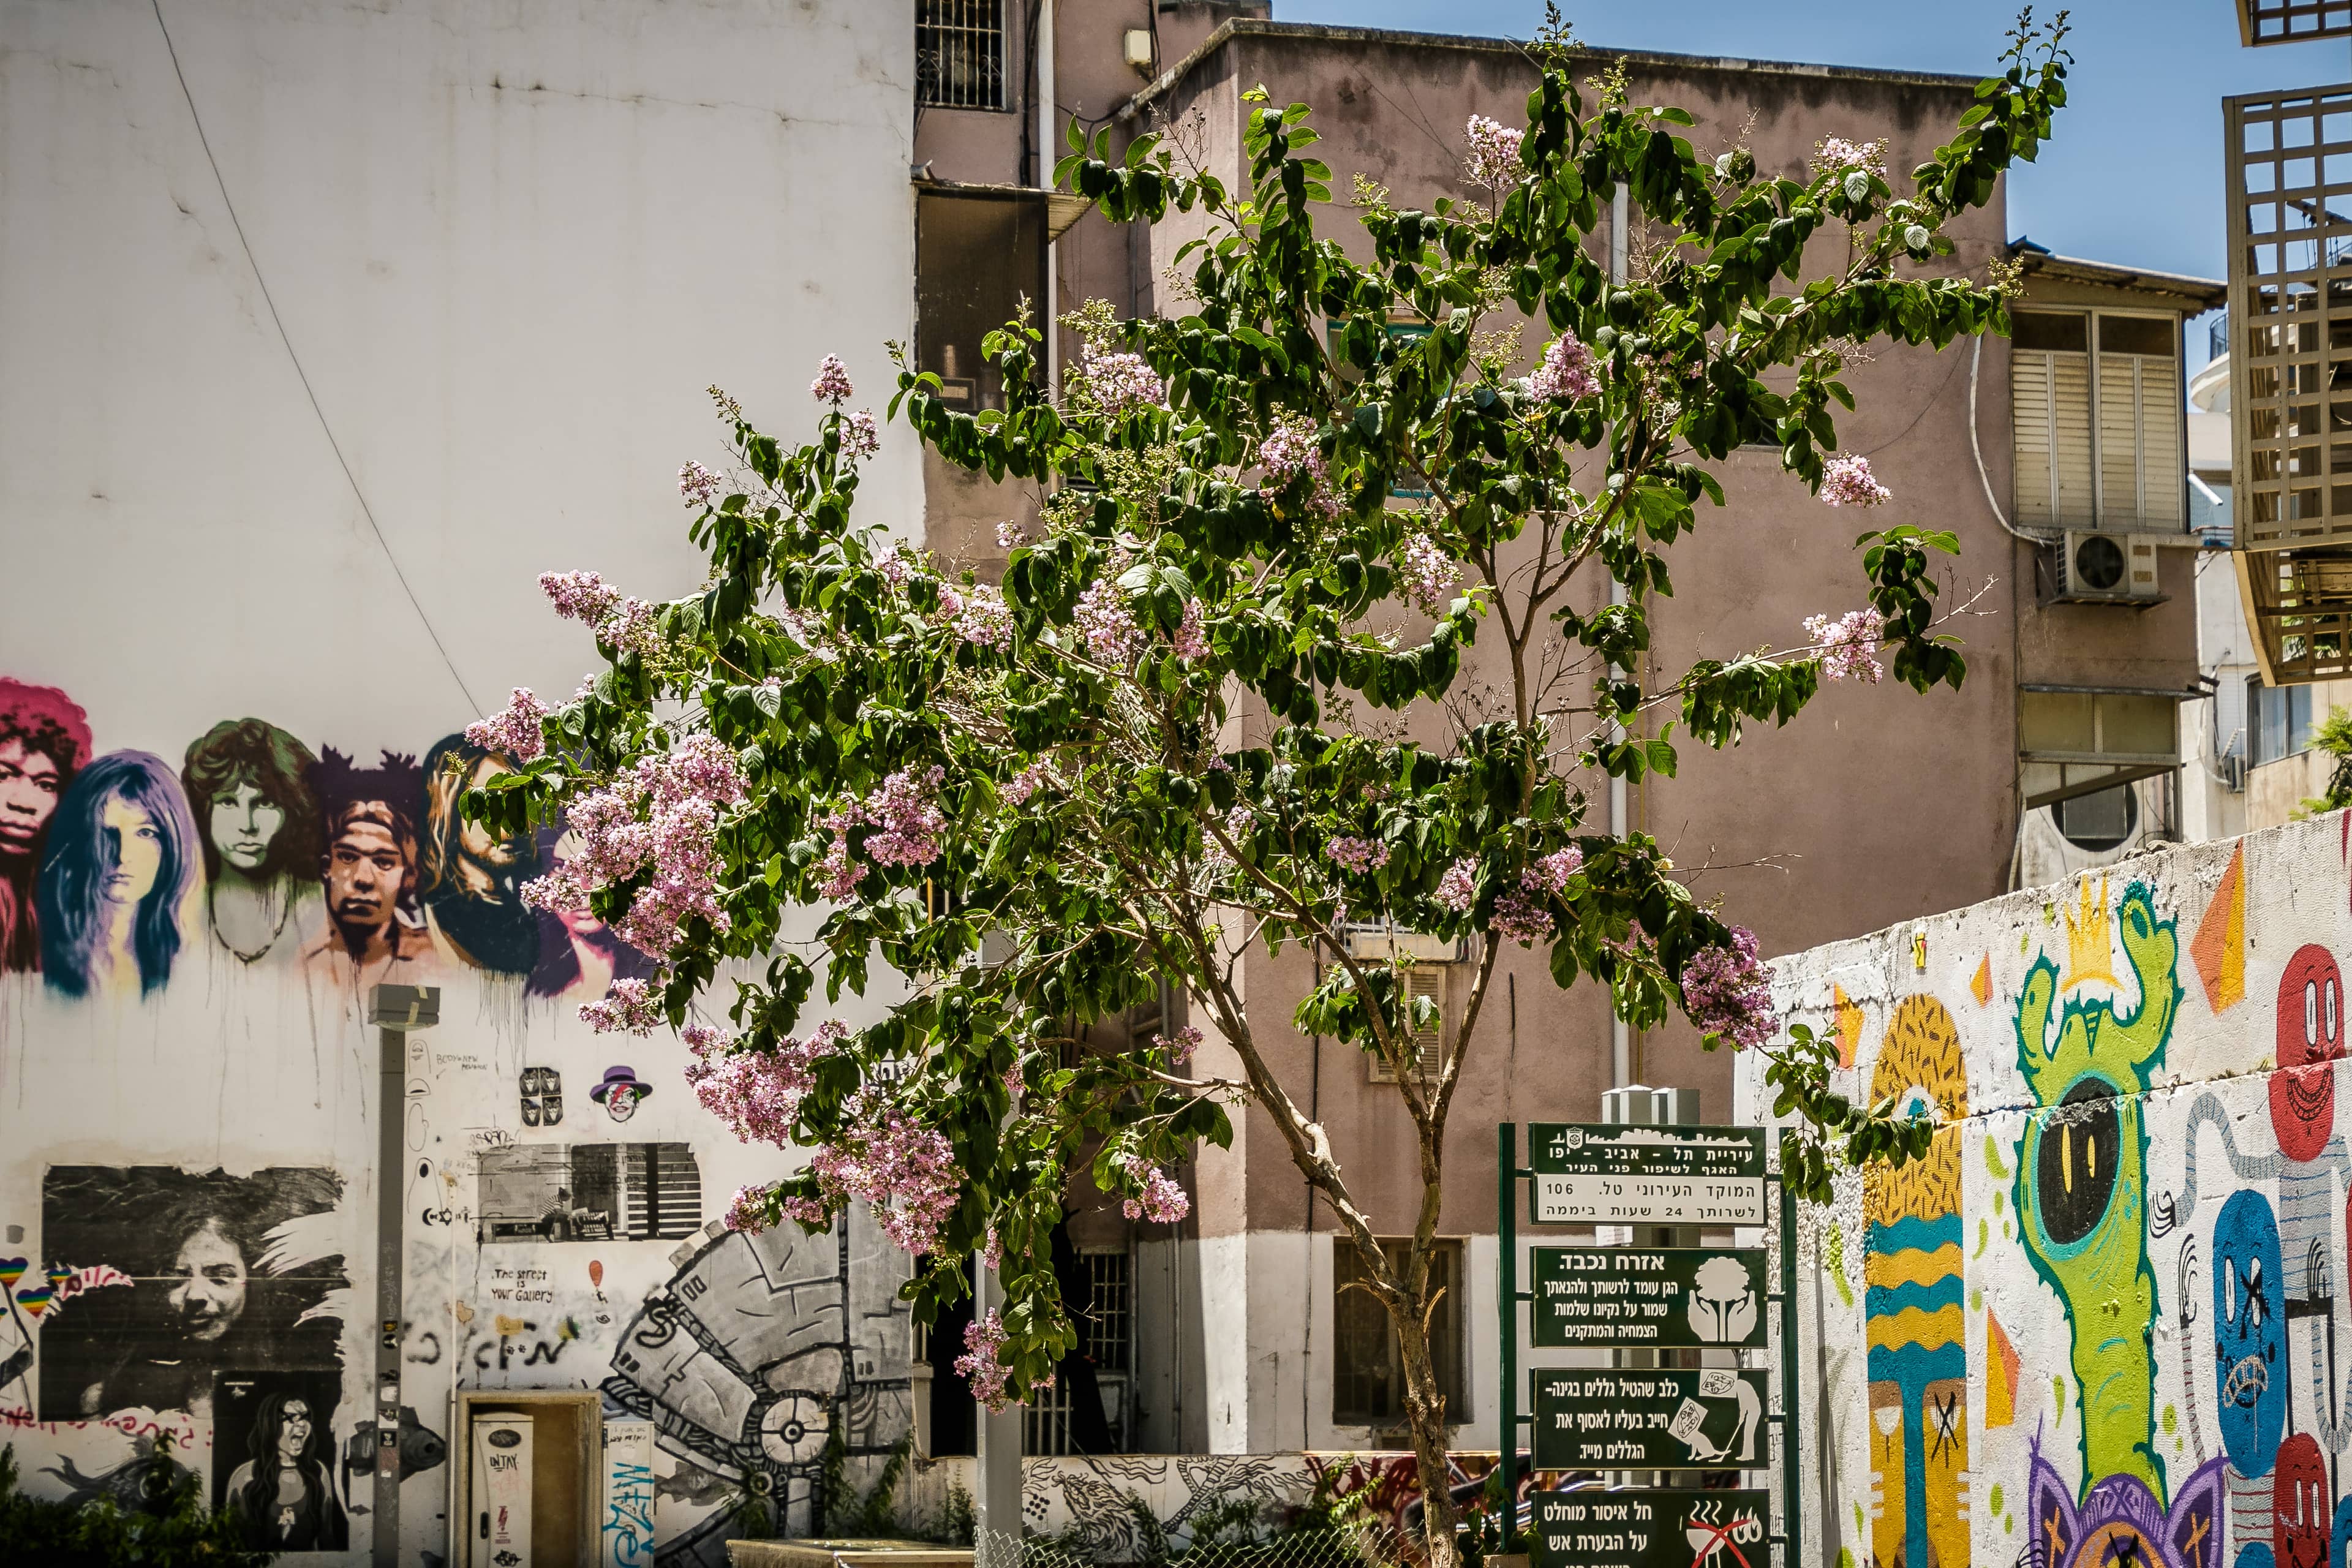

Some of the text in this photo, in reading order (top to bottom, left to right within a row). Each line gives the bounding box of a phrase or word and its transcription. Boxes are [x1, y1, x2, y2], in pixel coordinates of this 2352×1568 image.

[1550, 1147, 1570, 1158] יפו
[1604, 1148, 1639, 1159] אביב
[1673, 1147, 1693, 1161] תל
[1706, 1150, 1753, 1163] עיריית
[1566, 1164, 1598, 1173] העיר
[1642, 1164, 1690, 1174] לשיפור
[1702, 1166, 1737, 1176] האגף
[1547, 1181, 1755, 1199] המוקד העירוני טל. 106
[1547, 1206, 1755, 1219] לשרותך 24 שעות ביממה
[1559, 1254, 1665, 1270] אזרח נכבד.
[1544, 1278, 1678, 1298] הגן עומד לרשותך ולהנאתך
[1555, 1300, 1668, 1320] שמור על נקיונו שלמות
[1565, 1325, 1657, 1341] הצמחיה והמתקנים
[1585, 1378, 1615, 1397] גללים
[1619, 1378, 1655, 1398] שהטיל
[1659, 1378, 1679, 1397] כלב
[1556, 1409, 1668, 1433] חייב בעליו לאסוף את
[1580, 1440, 1645, 1460] הגללים מייד.
[1544, 1501, 1652, 1521] חל איסור מוחלט
[1548, 1530, 1647, 1553] על הבערת אש
